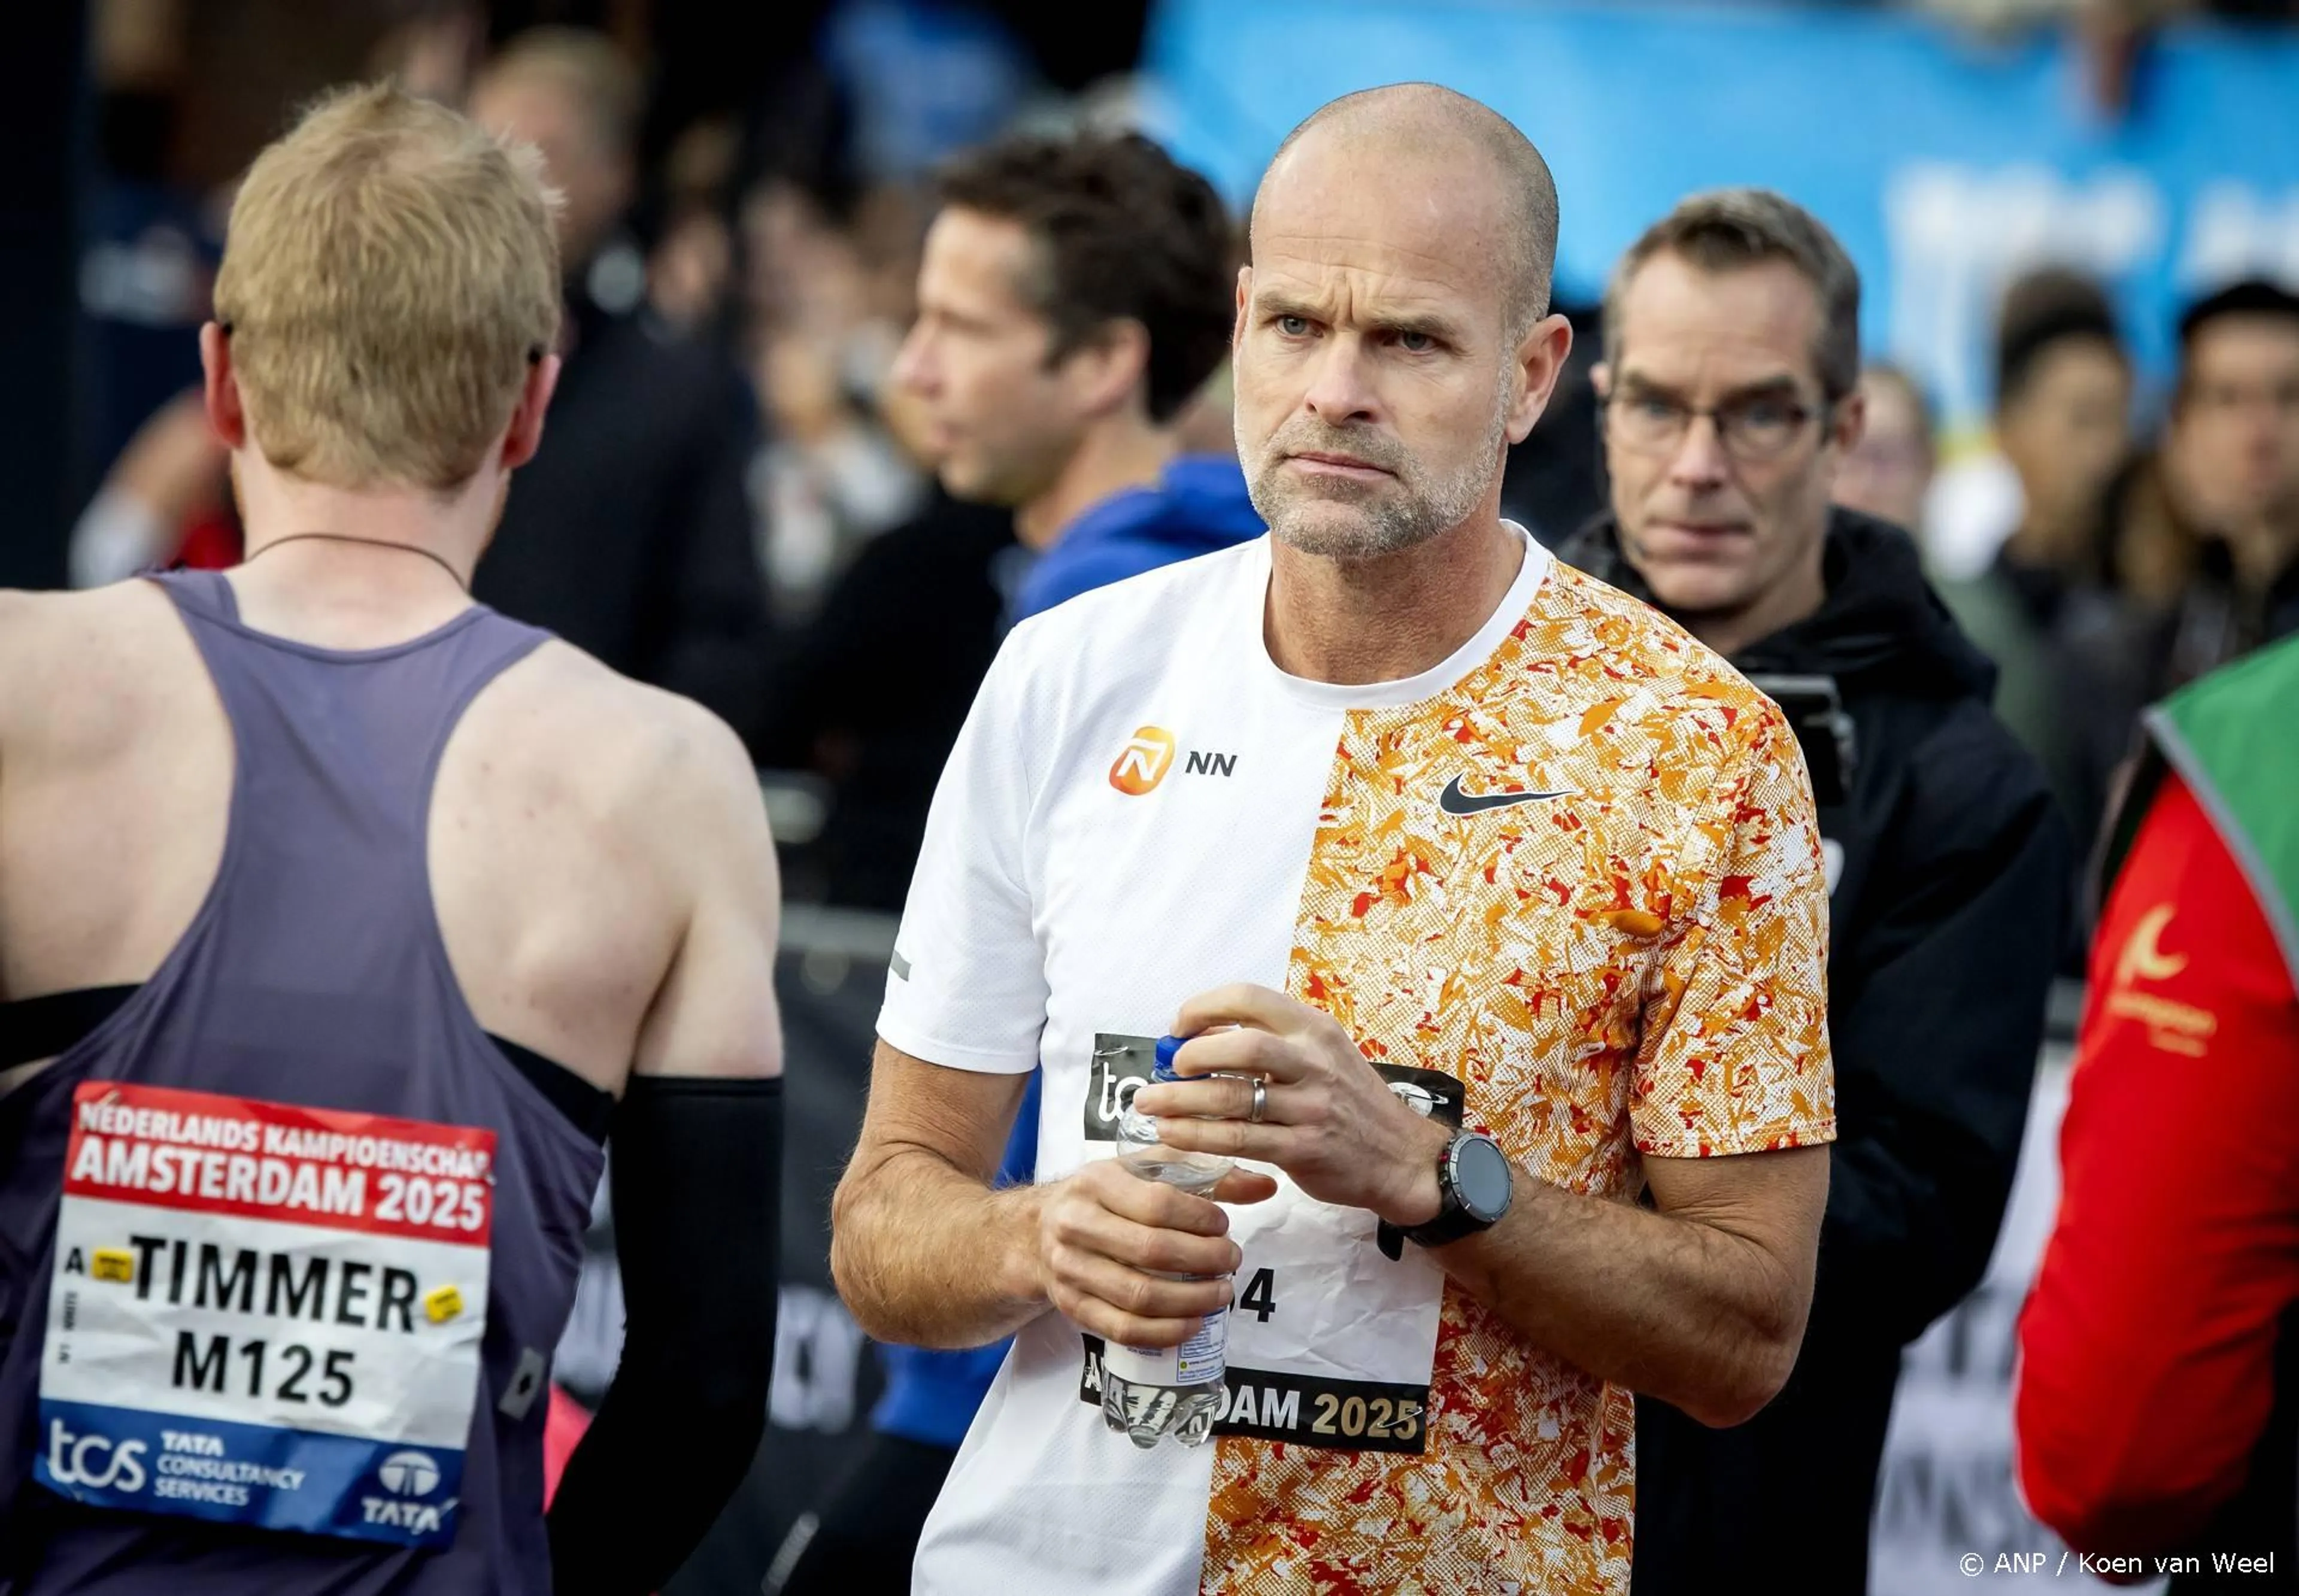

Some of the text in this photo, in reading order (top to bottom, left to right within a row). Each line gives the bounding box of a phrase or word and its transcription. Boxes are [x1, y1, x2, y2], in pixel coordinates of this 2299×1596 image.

[1185, 751, 1238, 777] NN
[78, 1102, 260, 1151] NEDERLANDS
[71, 1135, 486, 1231] AMSTERDAM 2025
[65, 1246, 84, 1276] A
[129, 1234, 418, 1333] TIMMER
[172, 1331, 355, 1407] M125
[1312, 1393, 1418, 1440] 2025
[47, 1418, 148, 1492] tcs
[160, 1429, 224, 1457] TATA
[153, 1476, 250, 1506] SERVICES
[156, 1455, 306, 1490] CONSULTANCY
[361, 1496, 441, 1535] TATA
